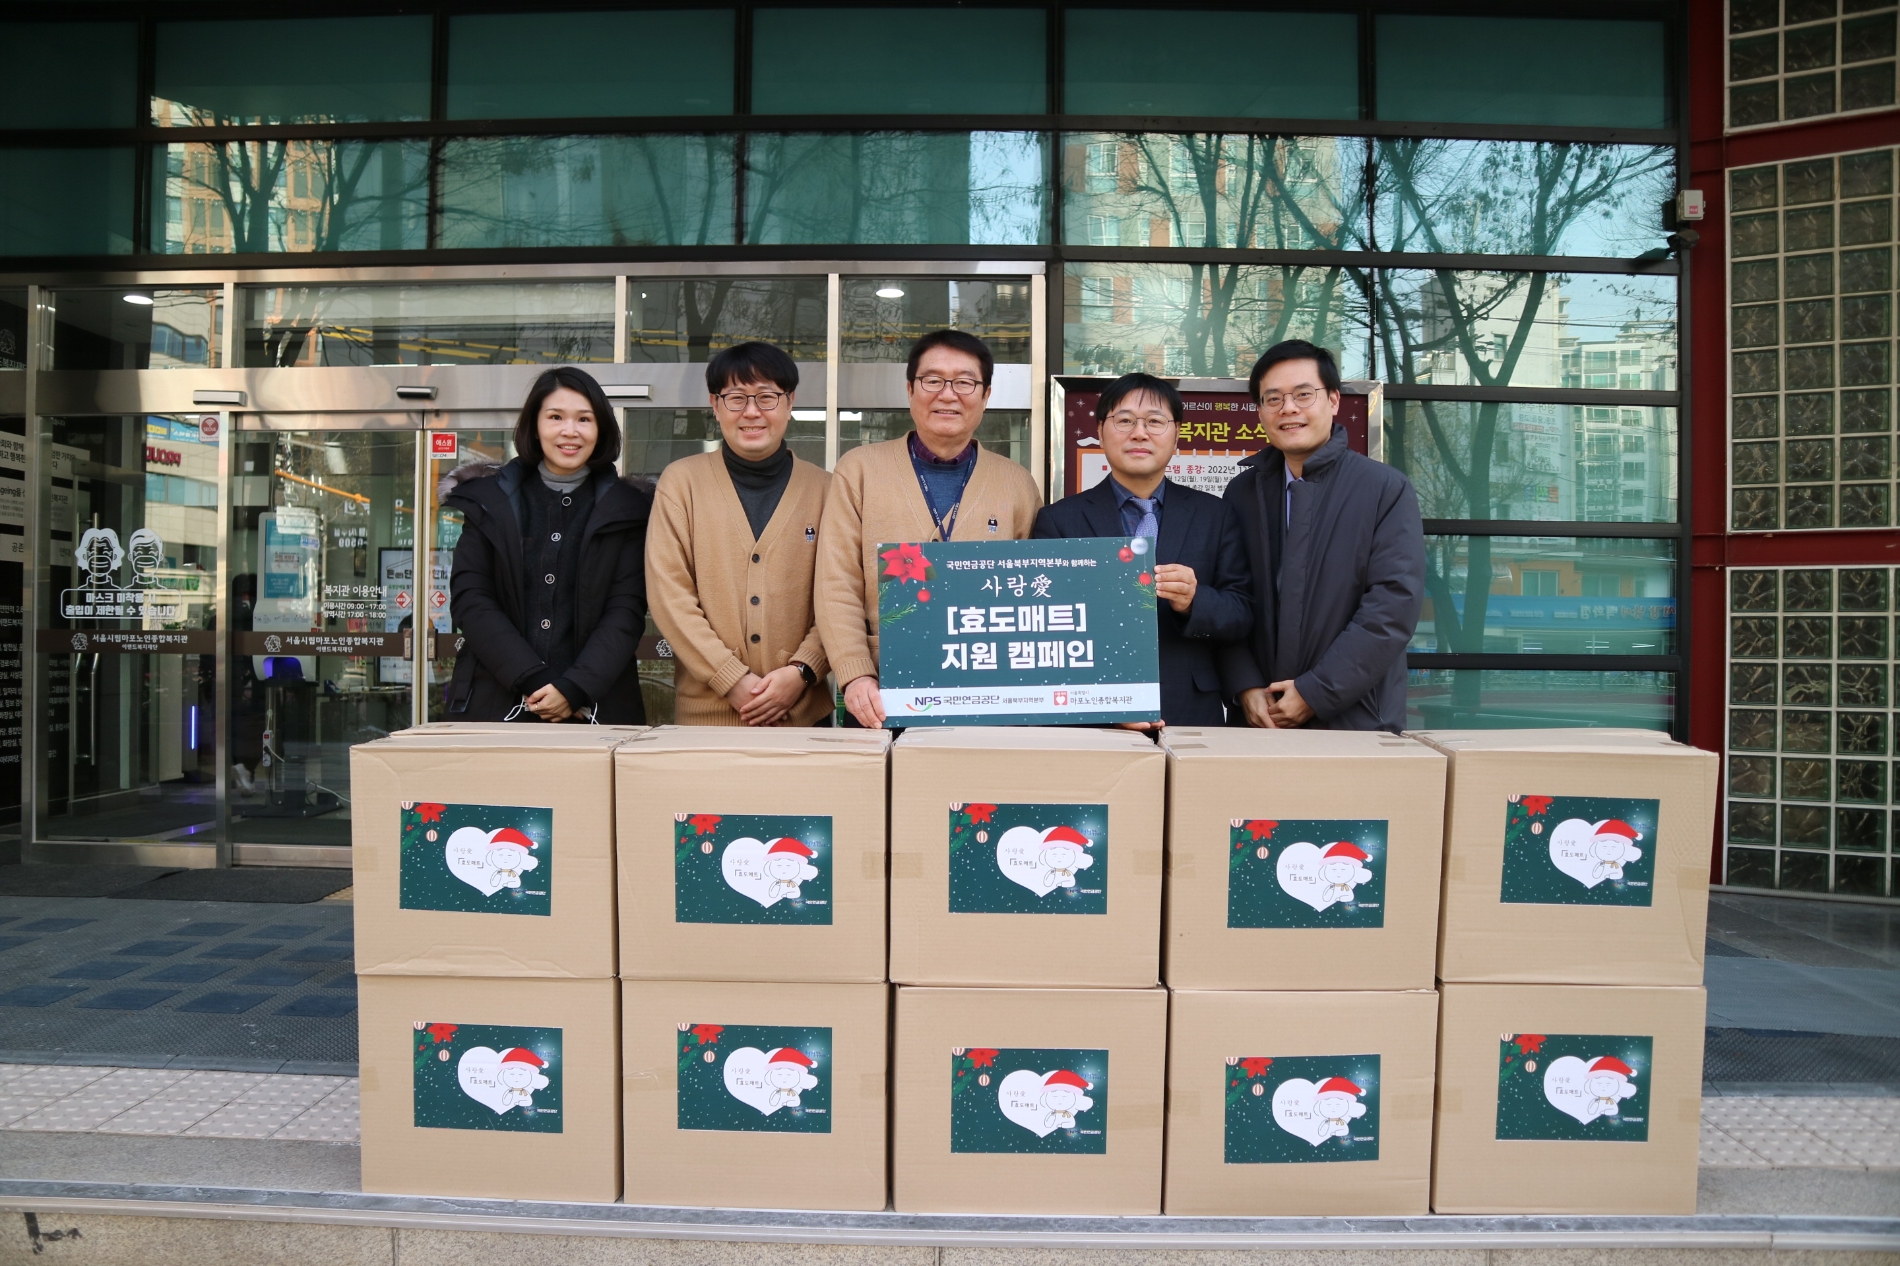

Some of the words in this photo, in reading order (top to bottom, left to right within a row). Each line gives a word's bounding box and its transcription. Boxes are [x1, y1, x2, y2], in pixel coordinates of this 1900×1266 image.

[1214, 402, 1238, 411] 행복한
[1241, 402, 1258, 412] 시립
[1179, 422, 1231, 442] 복지관
[1186, 465, 1205, 474] 종강:
[1208, 466, 1235, 474] 2022년
[946, 560, 995, 570] 국민연금공단
[997, 558, 1069, 569] 서울북부지역본부와
[1071, 558, 1097, 567] 함께하는
[324, 585, 350, 597] 복지관
[352, 585, 387, 597] 이용안내
[980, 574, 1052, 598] 사랑愛
[86, 593, 113, 603] 마스크
[116, 593, 144, 603] 미착용
[66, 605, 93, 615] 출입이
[126, 606, 136, 615] 수
[138, 605, 176, 616] 있습니다
[947, 603, 1087, 635] [효도매트]
[92, 634, 188, 643] 서울시립마포노인종합복지관
[286, 636, 384, 646] 서울시립마포노인종합복지관
[941, 642, 998, 670] 지원
[1008, 640, 1094, 670] 캠페인
[915, 696, 941, 706] NPS
[943, 695, 1000, 705] 국민연금공단
[1002, 696, 1044, 704] 서울북부지역본부
[1070, 696, 1132, 705] 마포노인종합복지관
